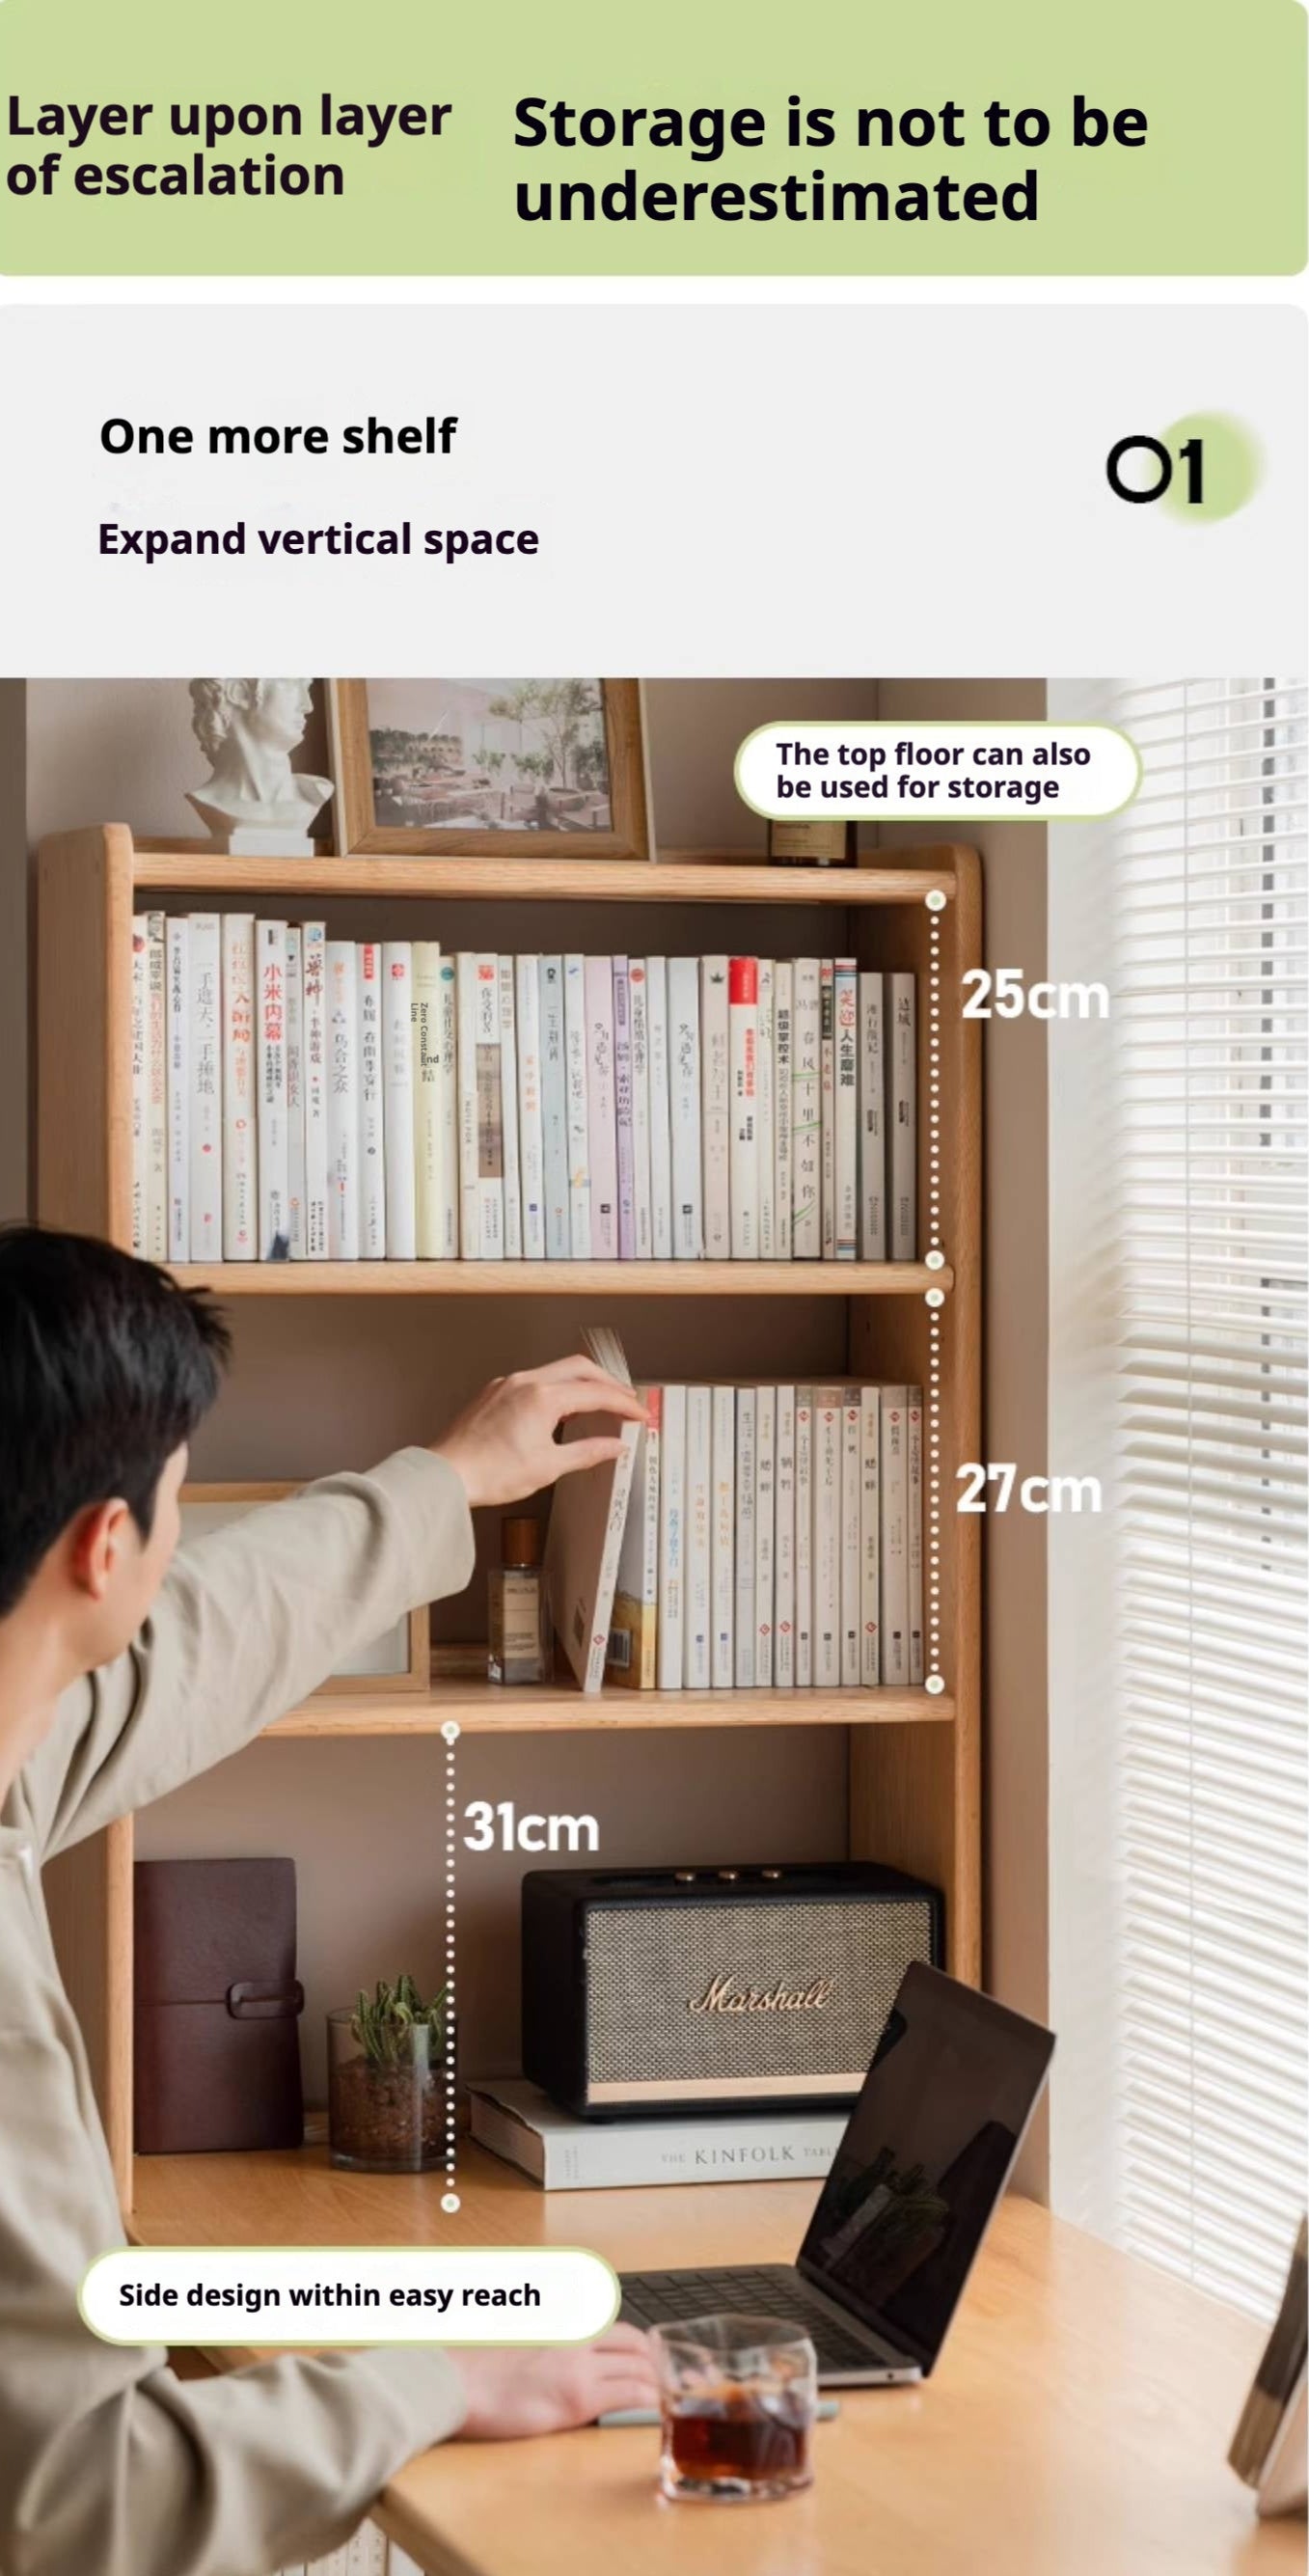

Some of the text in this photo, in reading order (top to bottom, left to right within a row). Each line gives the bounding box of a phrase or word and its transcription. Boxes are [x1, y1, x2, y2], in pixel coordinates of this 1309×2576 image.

[263, 964, 282, 1041] 小米内幕
[839, 989, 855, 1087] 笑迎人生磨难
[688, 1973, 834, 2014] Marshall
[695, 2146, 796, 2165] KINFOLK
[803, 2147, 837, 2157] TABL
